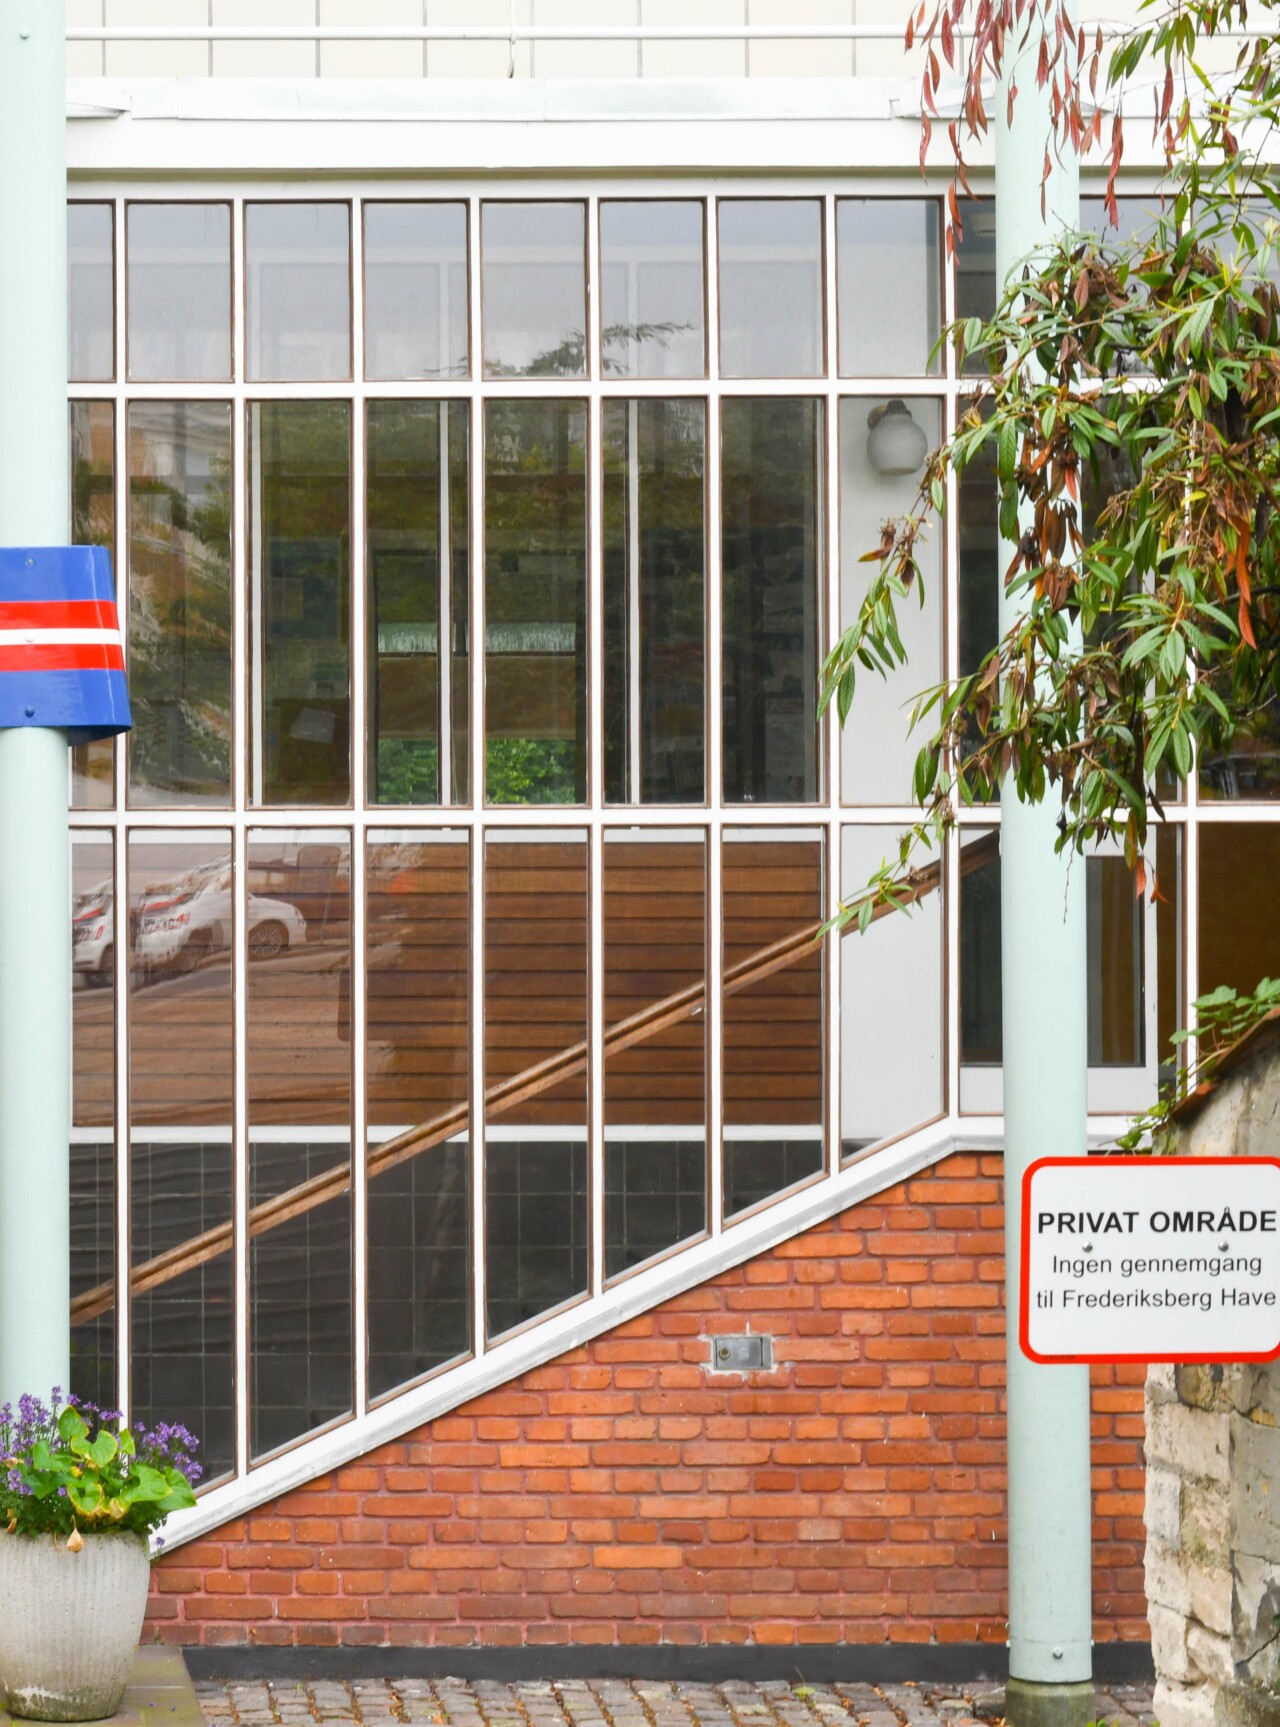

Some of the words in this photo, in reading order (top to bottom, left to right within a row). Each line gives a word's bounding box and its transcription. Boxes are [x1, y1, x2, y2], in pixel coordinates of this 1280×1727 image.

[1037, 1211, 1140, 1234] PRIVAT
[1149, 1206, 1277, 1233] OMRÅDE
[1052, 1255, 1113, 1279] Ingen
[1120, 1257, 1262, 1278] gennemgang
[1036, 1290, 1053, 1309] til
[1062, 1288, 1213, 1312] Frederiksberg
[1221, 1287, 1277, 1307] Have
